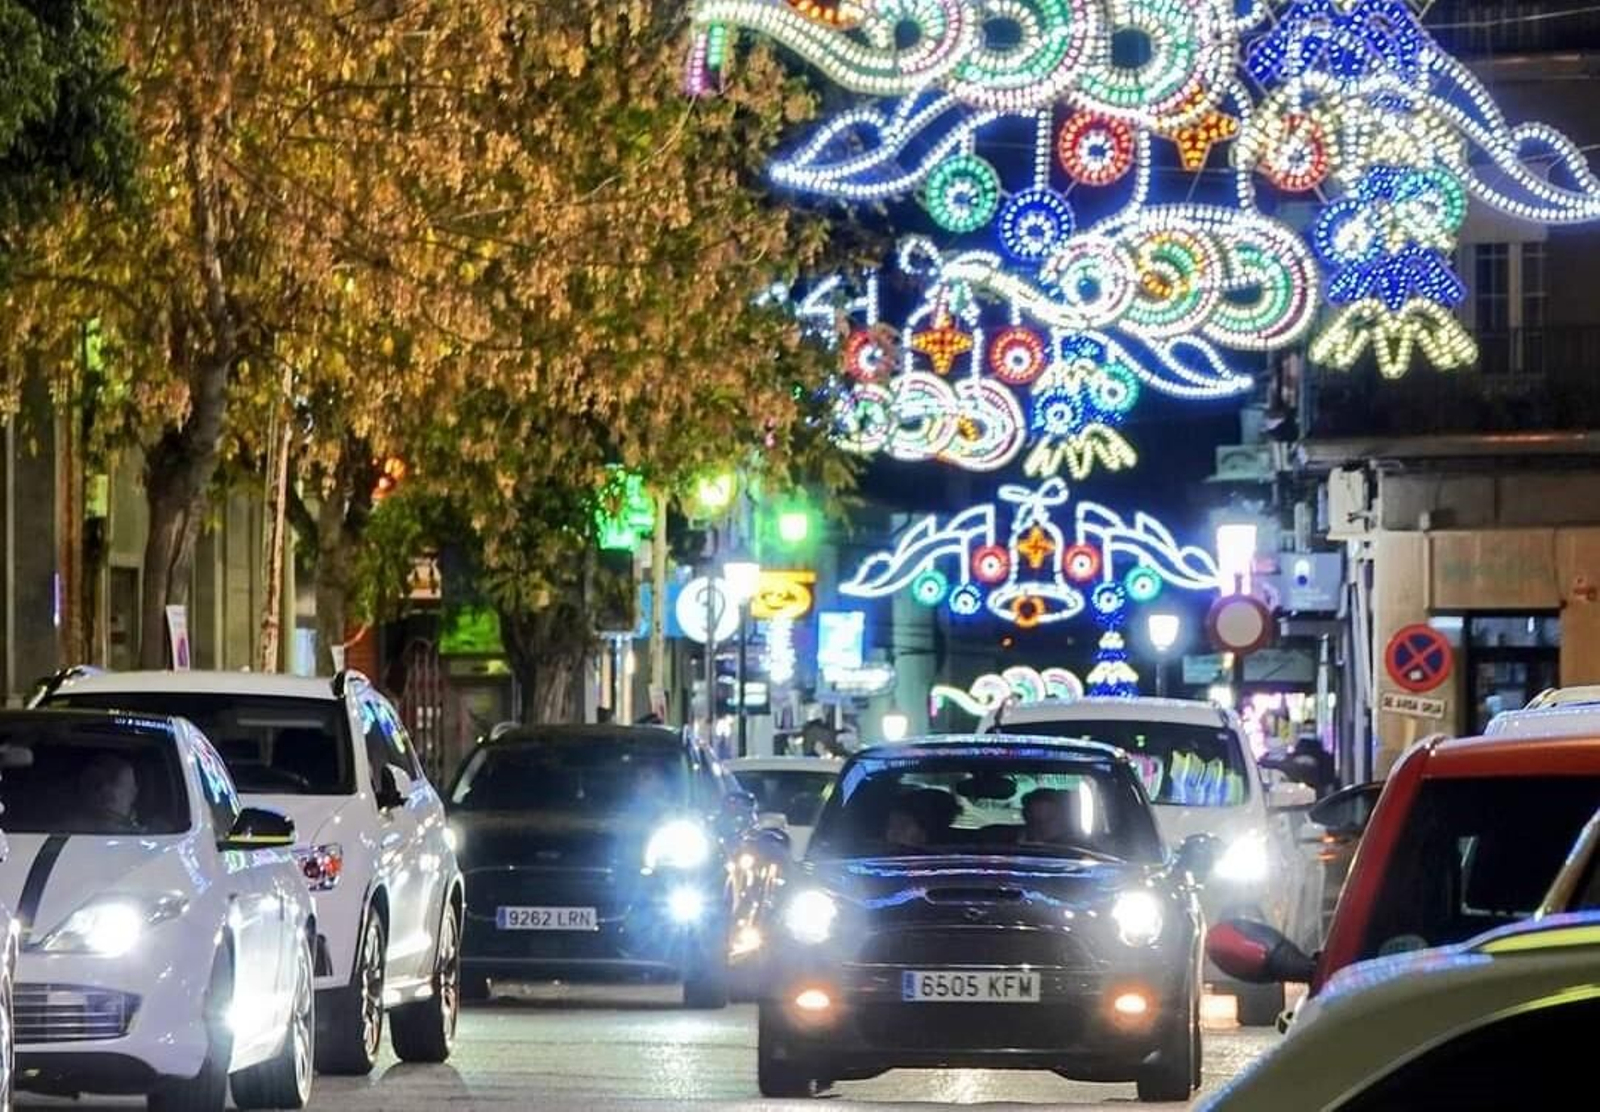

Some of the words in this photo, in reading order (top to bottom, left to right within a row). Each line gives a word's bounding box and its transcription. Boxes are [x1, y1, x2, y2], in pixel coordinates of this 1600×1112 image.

[509, 910, 552, 926] 9262
[557, 910, 591, 926] LRN
[921, 975, 979, 997] 6505
[988, 975, 1032, 997] KFM
